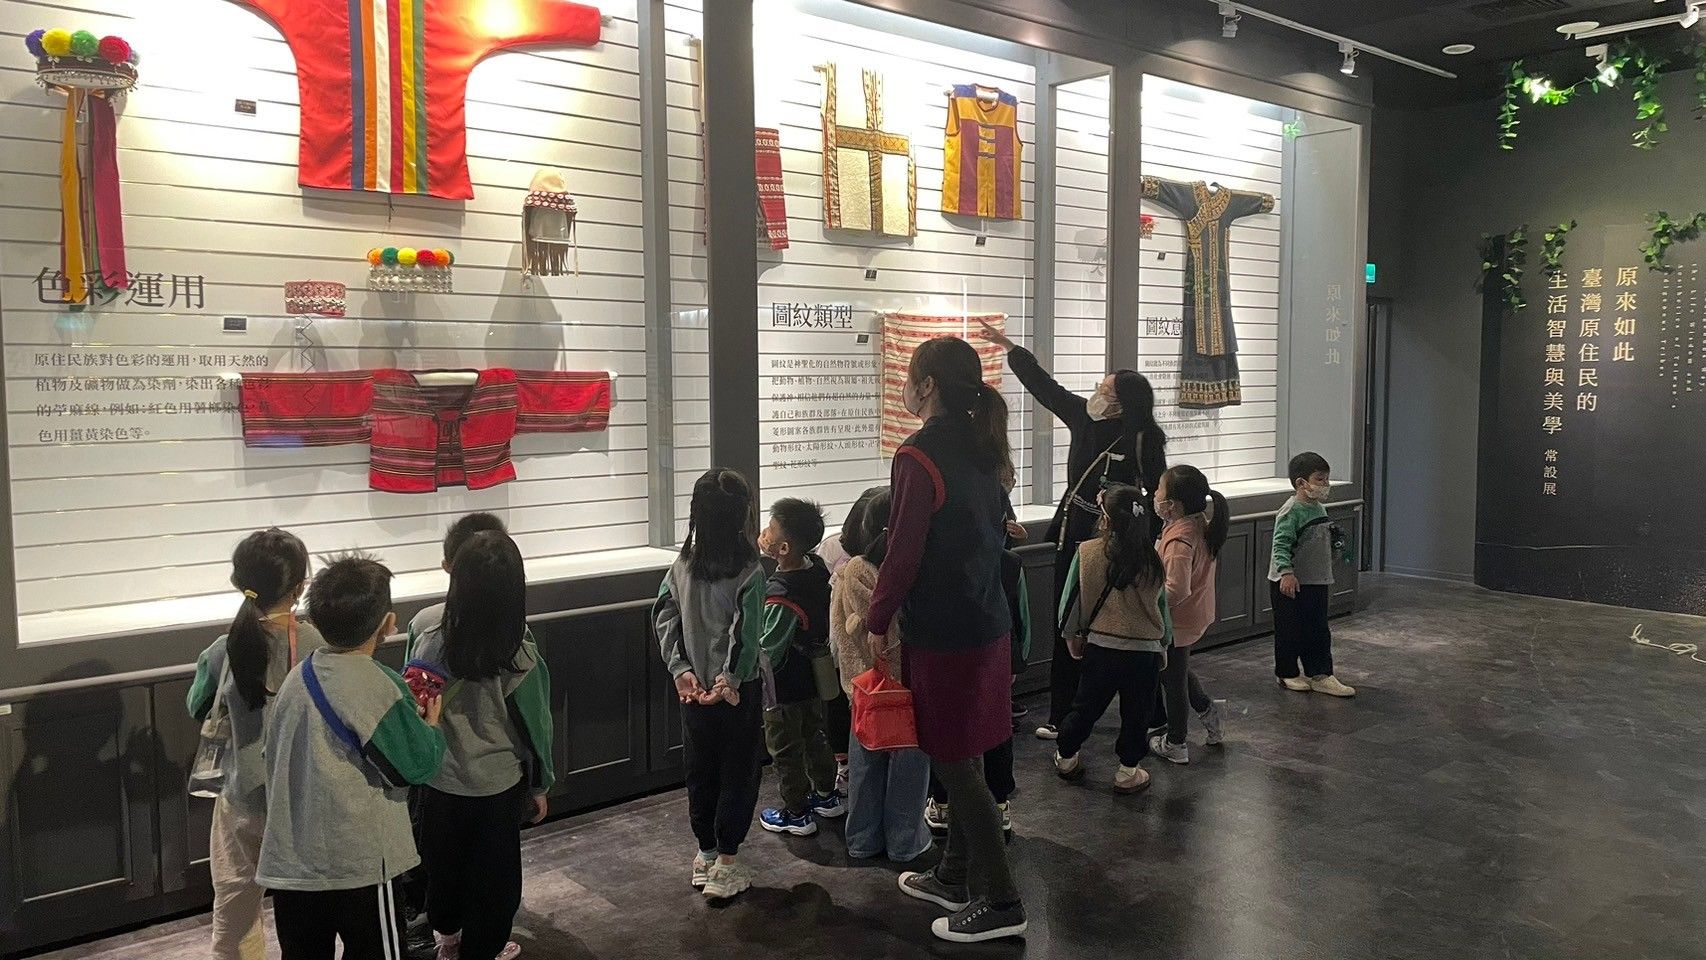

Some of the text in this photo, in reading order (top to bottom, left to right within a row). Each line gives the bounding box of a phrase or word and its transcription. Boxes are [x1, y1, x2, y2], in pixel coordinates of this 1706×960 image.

[32, 266, 205, 308] 色彩運用
[772, 302, 853, 330] 圖紋類型
[1612, 265, 1638, 362] 原來如此
[1542, 269, 1568, 495] 生活智慧與美學 常設展
[1577, 267, 1603, 412] 臺灣原住民的
